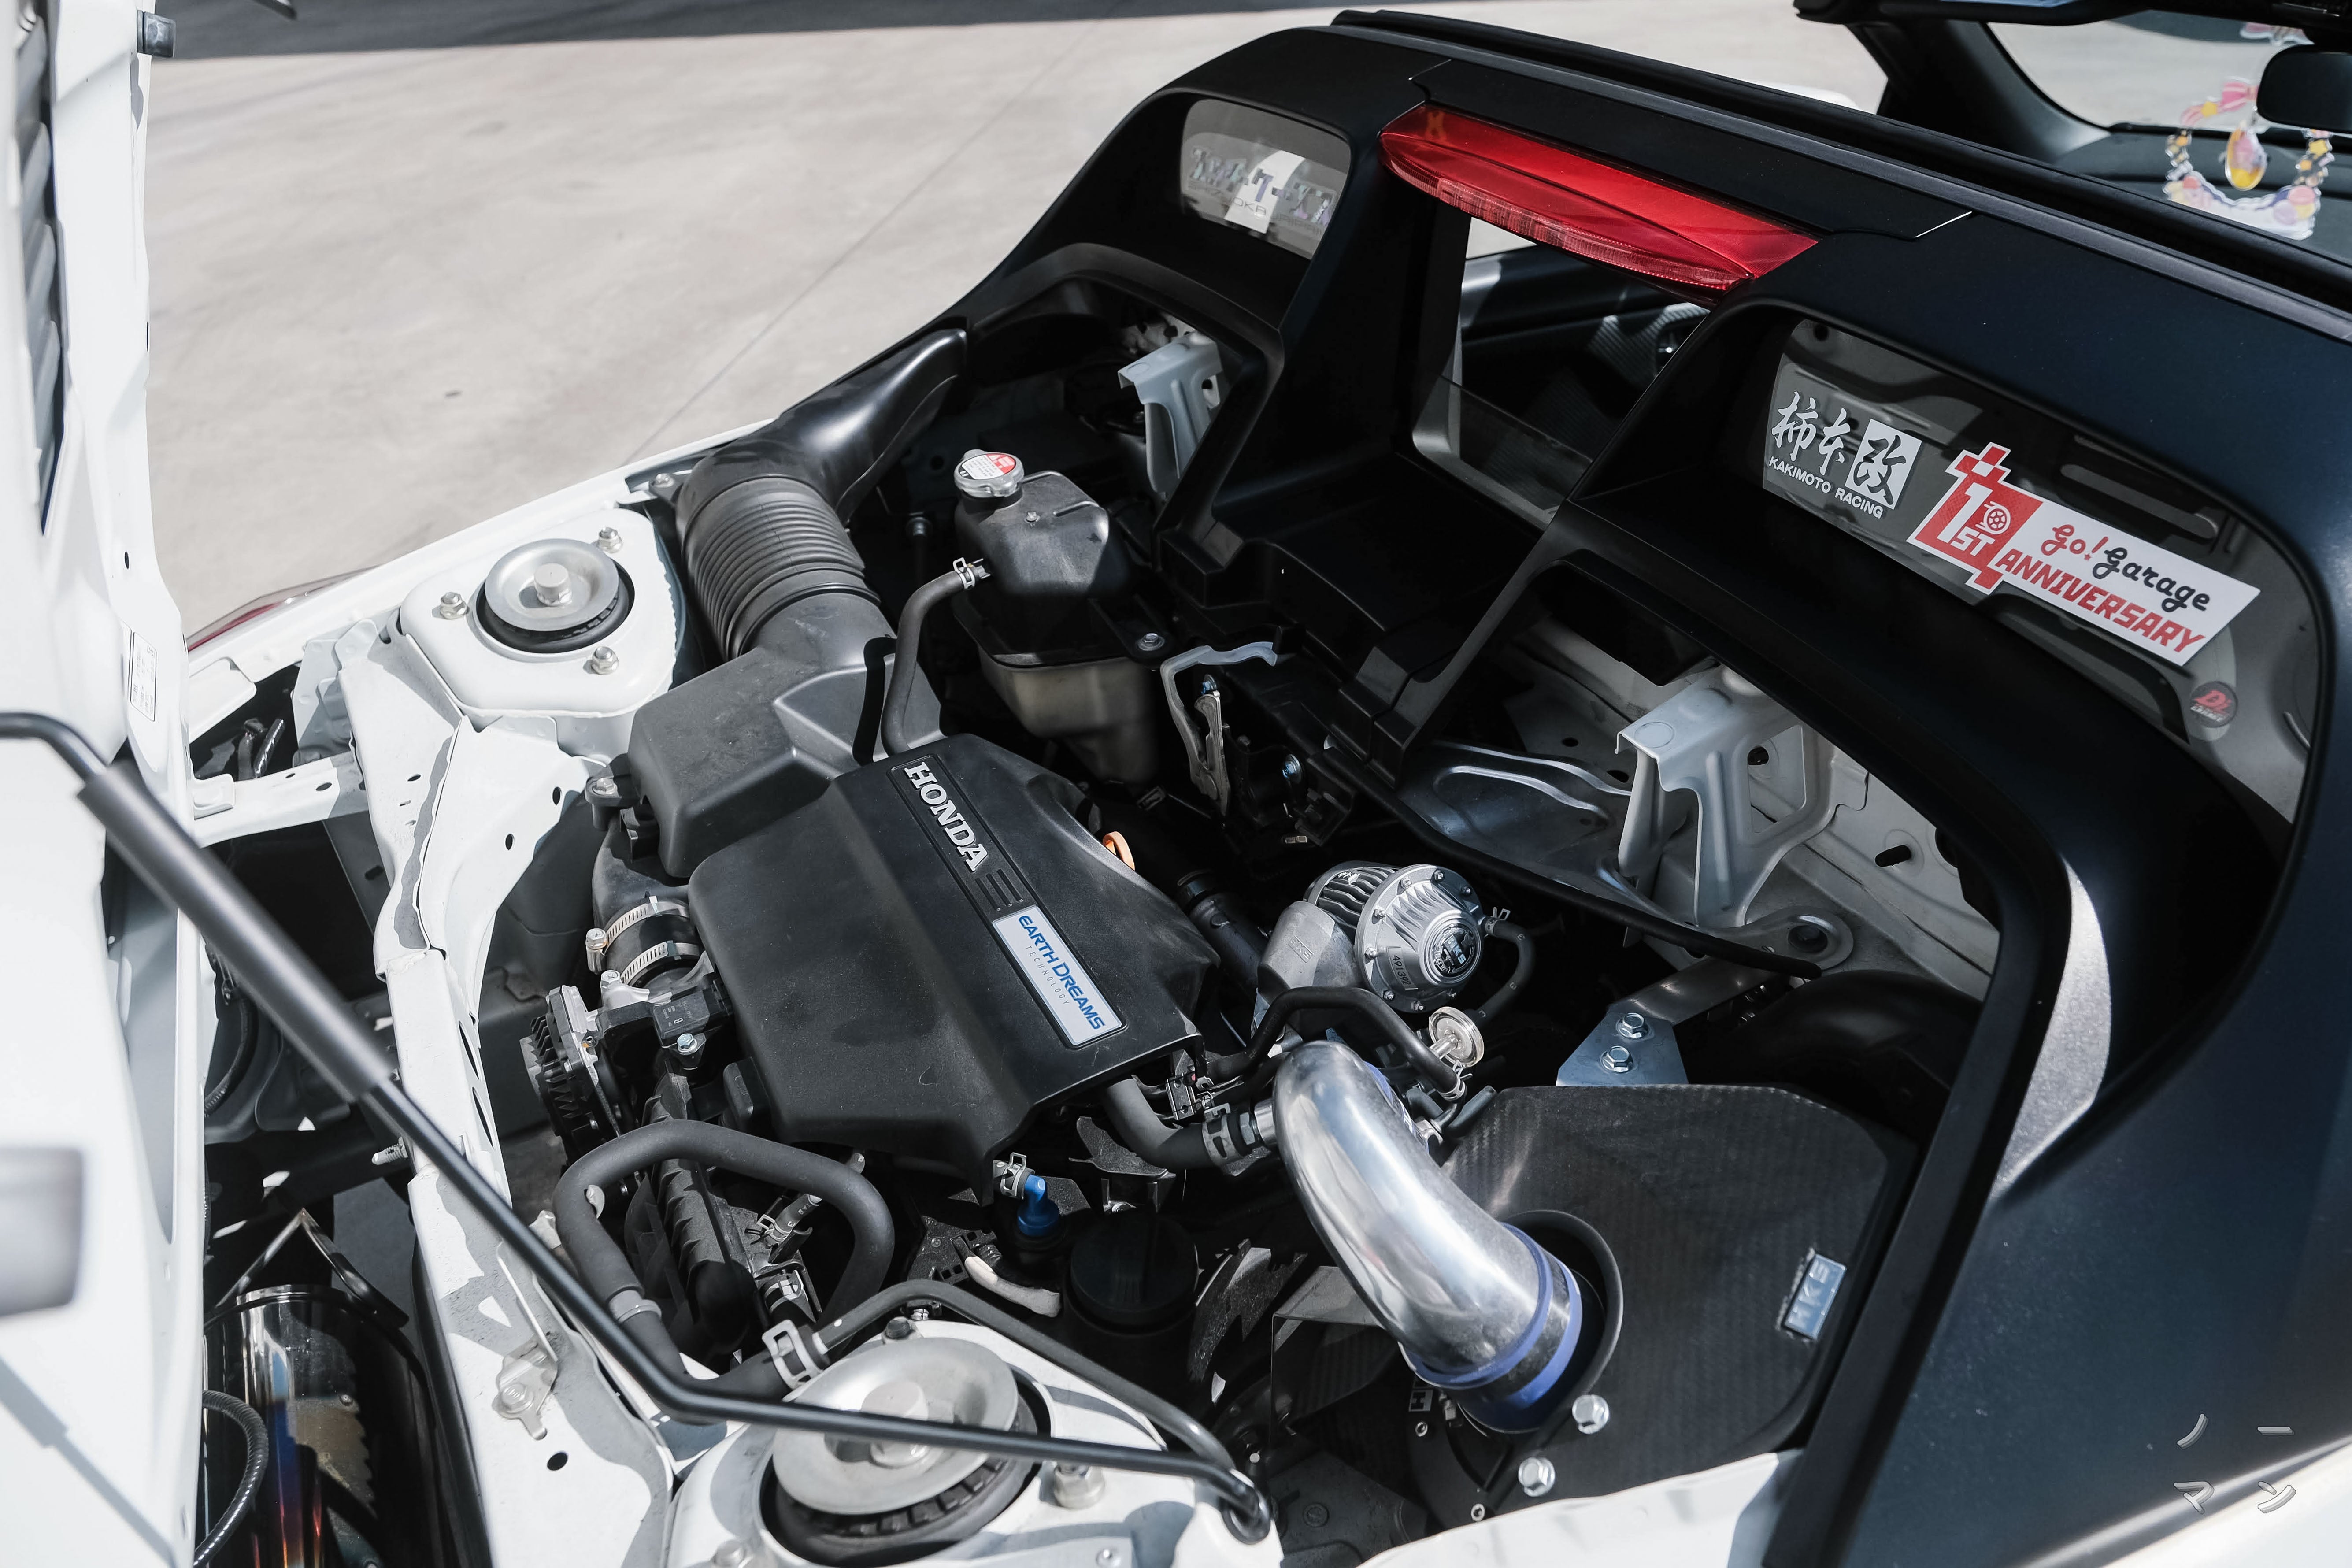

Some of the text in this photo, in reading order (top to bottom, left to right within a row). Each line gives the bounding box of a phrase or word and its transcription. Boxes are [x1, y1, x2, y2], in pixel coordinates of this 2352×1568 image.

[1769, 456, 1883, 519] KAKIMOTO RACING
[1995, 549, 2205, 652] ANNIVERSARY
[2093, 547, 2210, 612] Garage
[904, 762, 987, 871] HONDA
[1019, 915, 1105, 1030] EARTH DREAMS
[1026, 945, 1069, 1005] TECHNOLOGY
[1393, 955, 1411, 986] 491392
[1789, 1259, 1828, 1330] HKS
